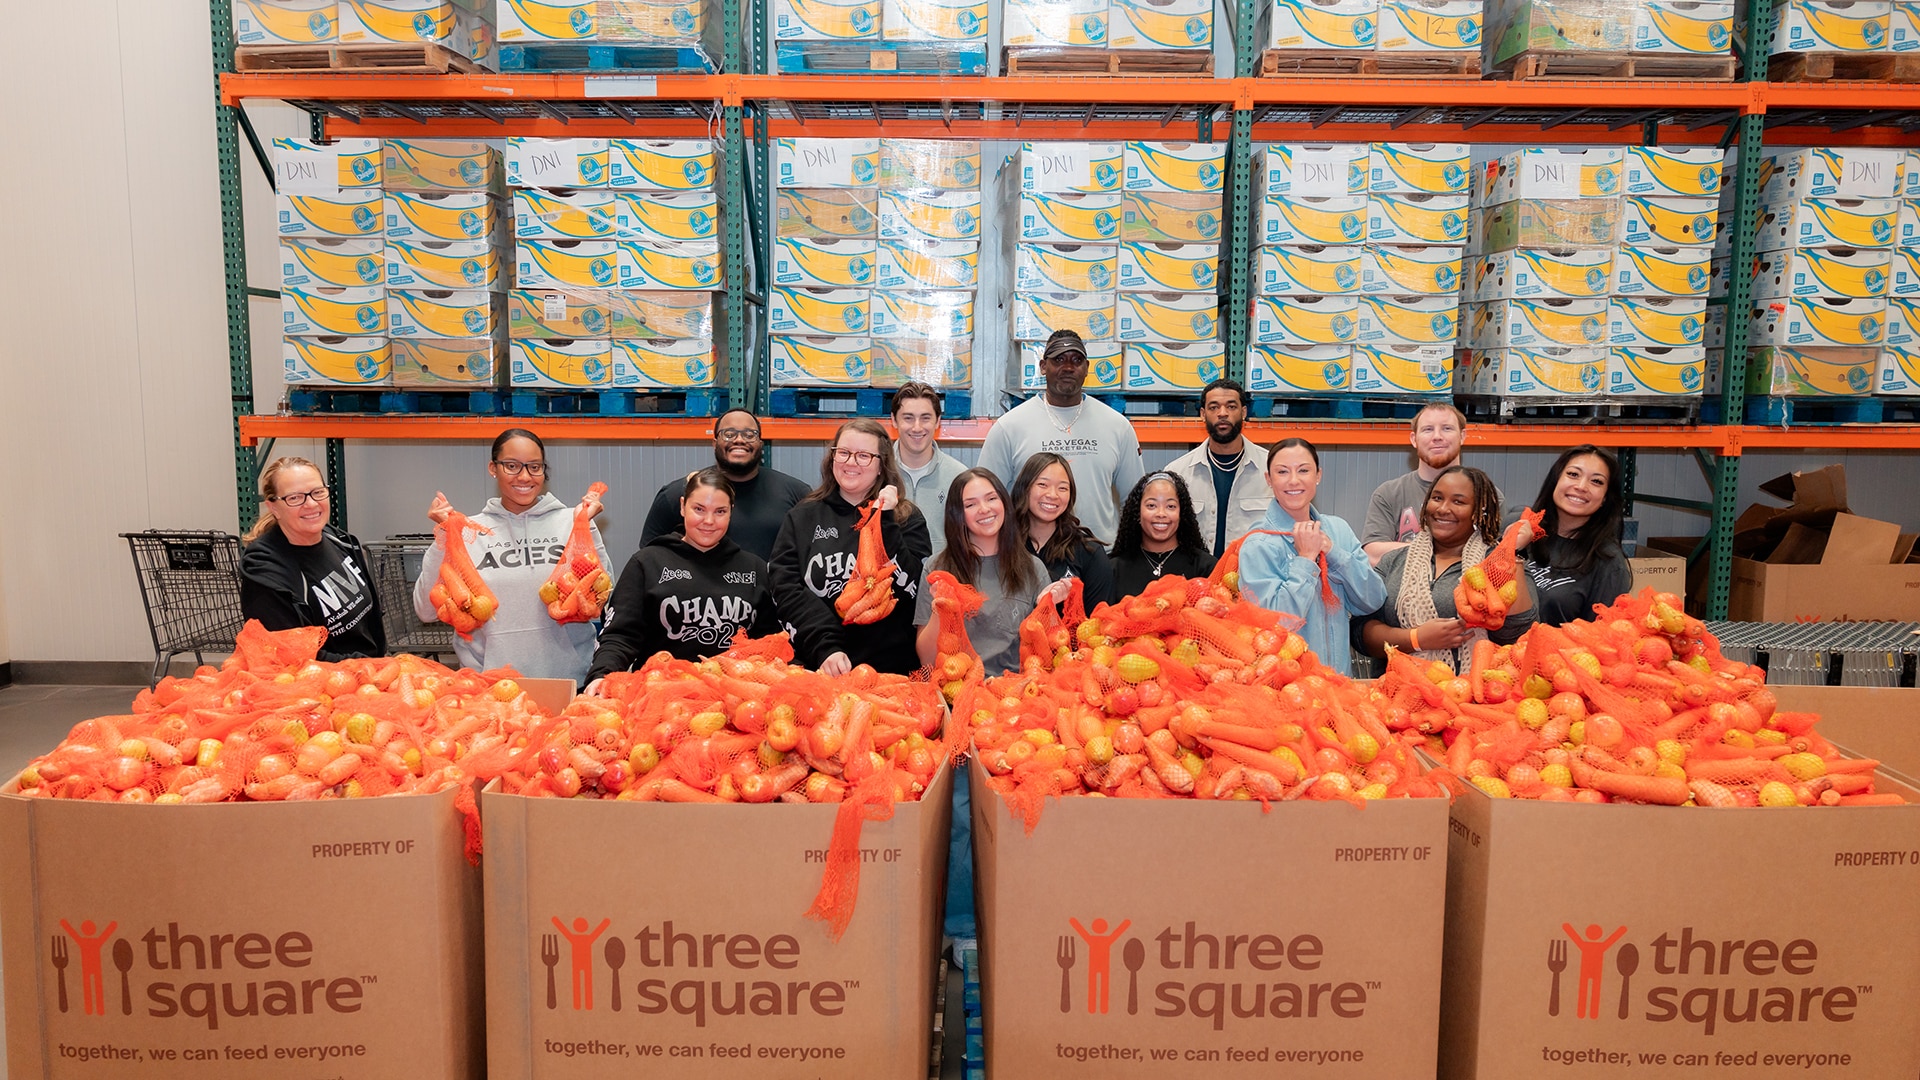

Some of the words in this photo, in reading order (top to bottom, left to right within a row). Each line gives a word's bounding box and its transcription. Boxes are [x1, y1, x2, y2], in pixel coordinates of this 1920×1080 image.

[1426, 16, 1452, 41] 12
[531, 150, 562, 176] DNI
[803, 146, 837, 168] DNI
[1042, 154, 1074, 175] DNI
[285, 160, 318, 181] DNI
[1303, 162, 1334, 183] DNI
[1534, 163, 1565, 184] DNI
[1850, 162, 1881, 184] DNI
[1064, 439, 1098, 447] VEGAS
[487, 541, 512, 549] LAS
[516, 536, 558, 545] VEGAS
[476, 544, 566, 570] ACES
[804, 552, 860, 598] CHA
[681, 622, 735, 648] 202
[1450, 817, 1471, 841] PERTY
[1472, 832, 1482, 848] OF
[312, 841, 391, 858] PROPERTY
[395, 839, 415, 854] OF
[804, 848, 879, 863] PROETY
[883, 848, 902, 863] OF
[1335, 847, 1409, 862] PROPERTY
[1413, 846, 1431, 861] OF
[1834, 851, 1907, 867] PROPERTY
[1910, 850, 1920, 865] O
[140, 921, 313, 971] three
[634, 920, 801, 970] three
[1154, 921, 1324, 971] three
[1649, 927, 1818, 976] three
[58, 1043, 144, 1063] together,
[148, 1049, 177, 1061] we
[182, 1048, 219, 1061] can
[223, 1044, 268, 1061] feed
[273, 1044, 366, 1062] everyone
[544, 1038, 630, 1058] together,
[635, 1044, 664, 1057] we
[668, 1045, 704, 1058] can
[708, 1042, 752, 1059] feed
[757, 1047, 846, 1062] everyone
[1055, 1043, 1144, 1063] together,
[1149, 1048, 1179, 1061] we
[1184, 1049, 1220, 1062] can
[1225, 1046, 1269, 1062] feed
[1274, 1050, 1364, 1066] everyone
[1541, 1046, 1632, 1067] together,
[1638, 1053, 1667, 1066] we
[1672, 1054, 1709, 1066] can
[1714, 1050, 1758, 1067] feed
[1762, 1053, 1852, 1069] everyone
